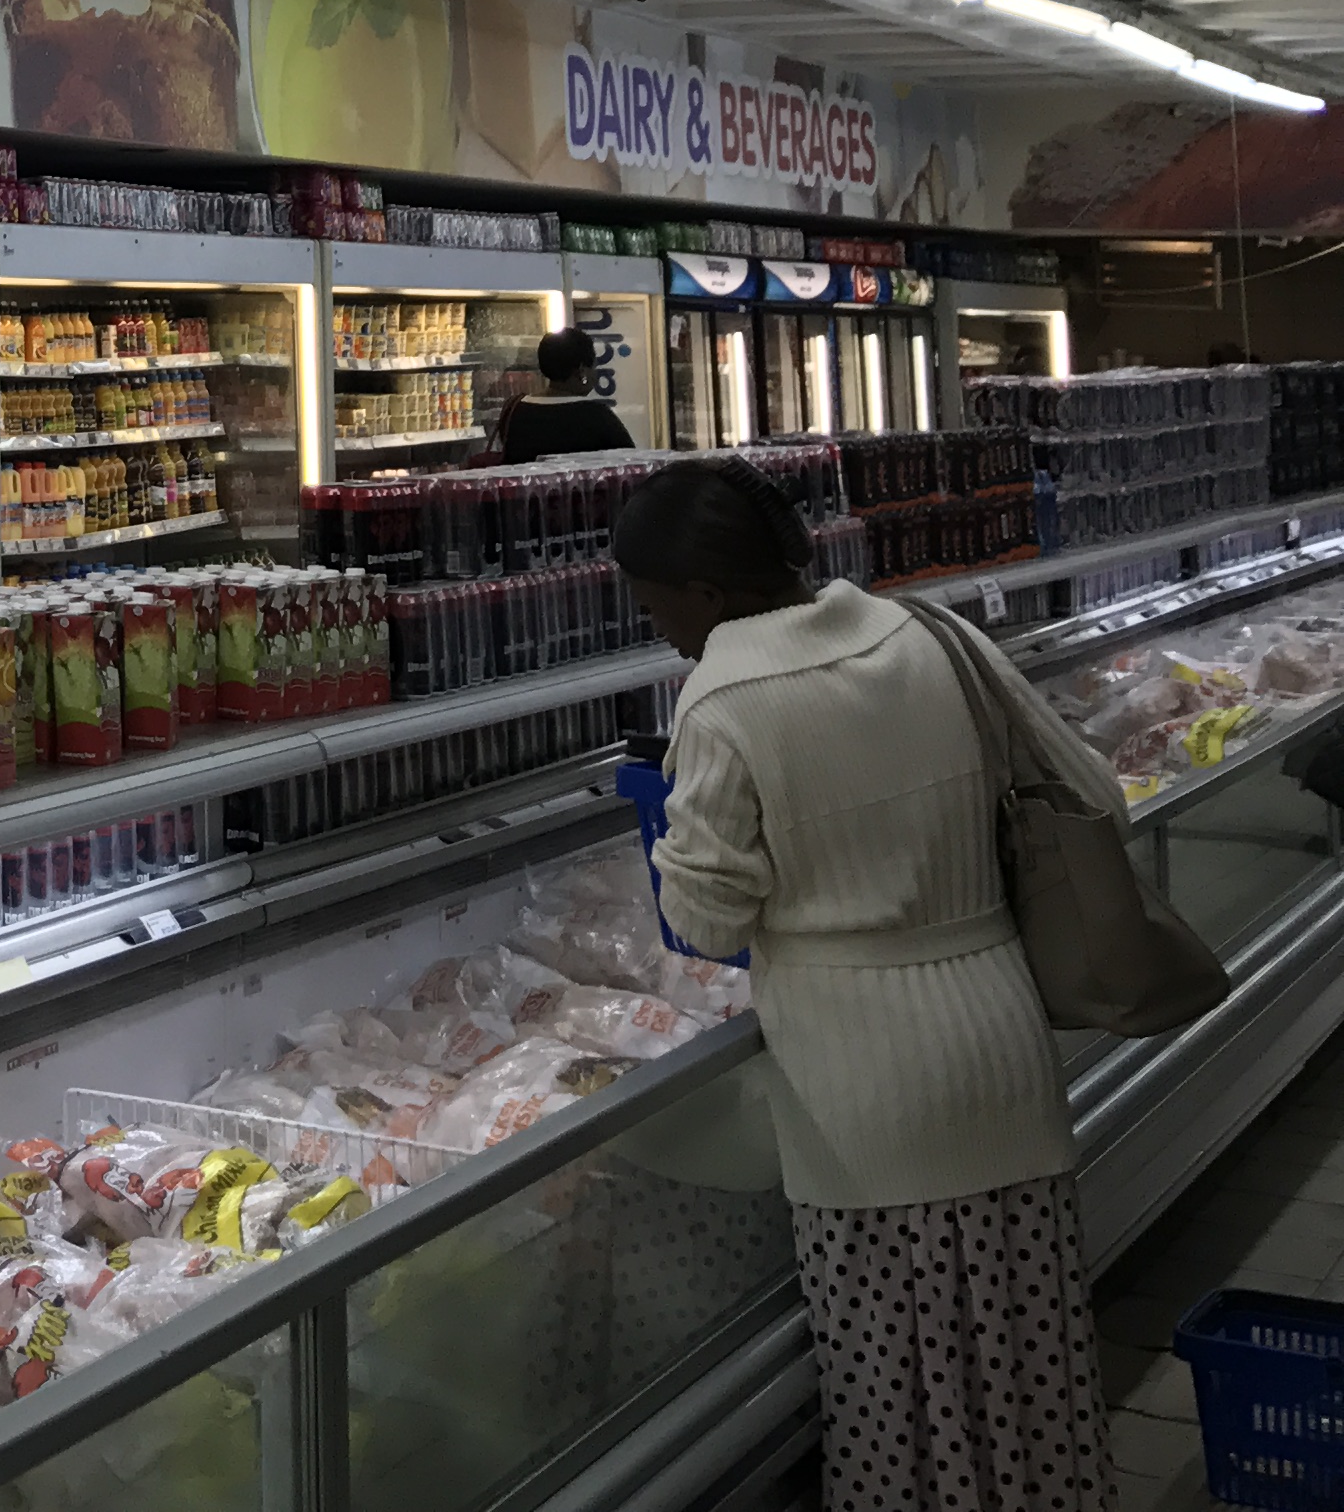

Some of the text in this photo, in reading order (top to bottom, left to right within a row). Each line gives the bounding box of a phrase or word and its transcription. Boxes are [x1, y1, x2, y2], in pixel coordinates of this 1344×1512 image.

[567, 54, 877, 187] DAIRY & BEVERAGES
